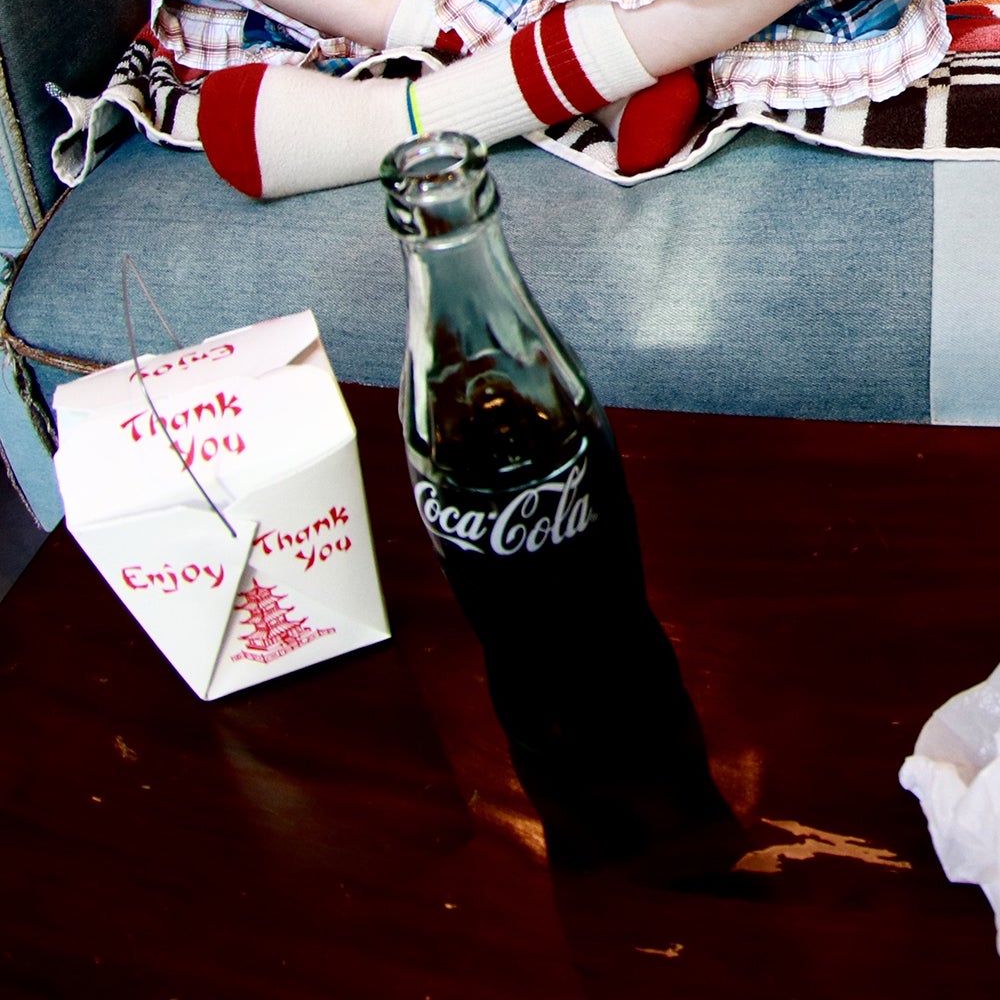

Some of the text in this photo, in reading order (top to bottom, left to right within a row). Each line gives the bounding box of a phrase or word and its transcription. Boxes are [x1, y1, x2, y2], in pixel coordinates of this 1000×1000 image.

[120, 391, 243, 442] Thank
[252, 506, 349, 555] Thank
[414, 456, 591, 556] Coca-Cola
[121, 563, 225, 593] Enjoy
